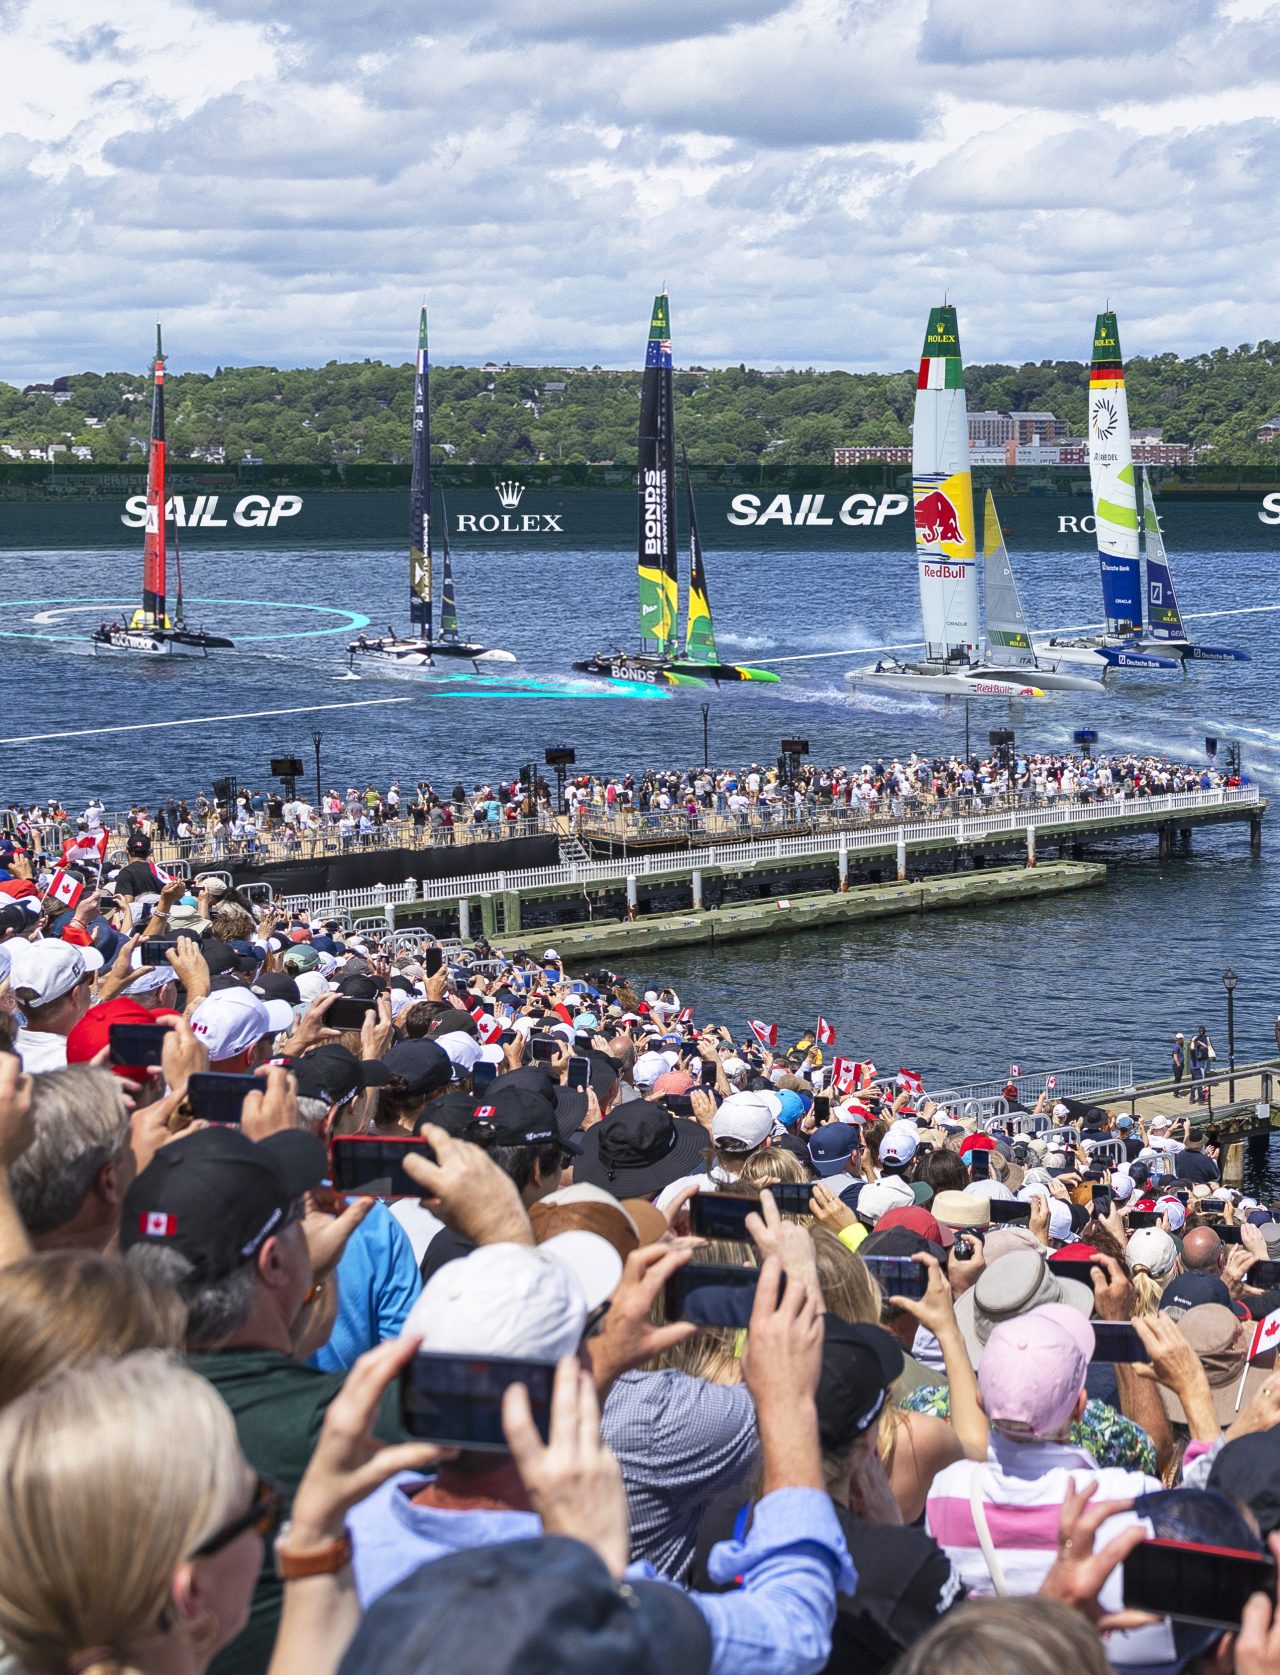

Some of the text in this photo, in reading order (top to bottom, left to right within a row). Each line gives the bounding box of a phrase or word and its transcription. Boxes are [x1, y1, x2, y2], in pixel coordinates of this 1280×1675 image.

[927, 335, 956, 343] ROLEX
[1094, 338, 1116, 347] ROLEX
[645, 470, 657, 555] BONDS
[1009, 640, 1027, 648] ROLEX
[1019, 657, 1032, 666] ITA
[611, 665, 656, 683] BONDS
